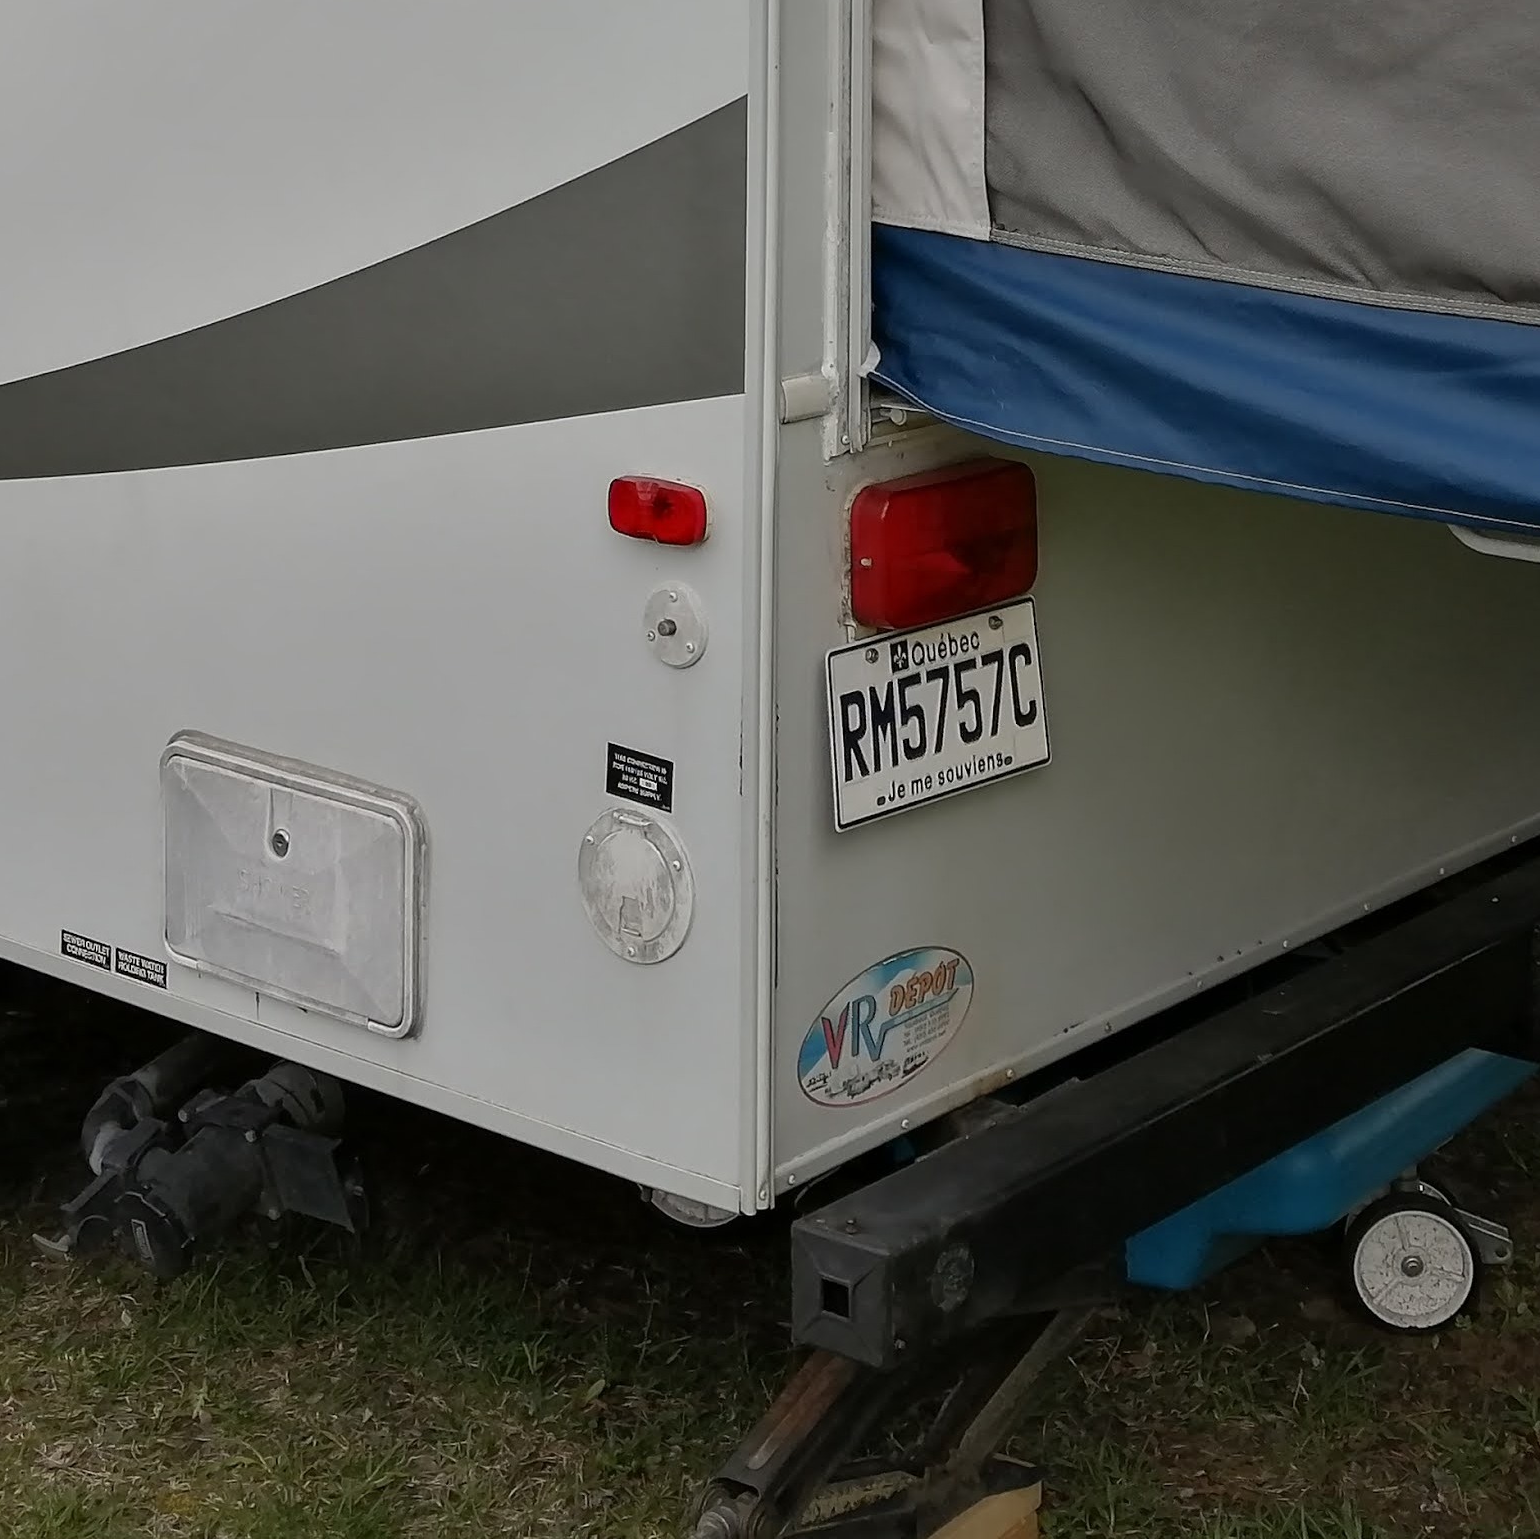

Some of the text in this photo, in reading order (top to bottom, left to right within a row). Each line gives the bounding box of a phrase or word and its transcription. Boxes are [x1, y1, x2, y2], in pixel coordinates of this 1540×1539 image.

[911, 631, 980, 666] Québec
[839, 642, 1037, 783] RM5757C
[888, 751, 1004, 802] Je me souviens
[821, 995, 881, 1069] VR
